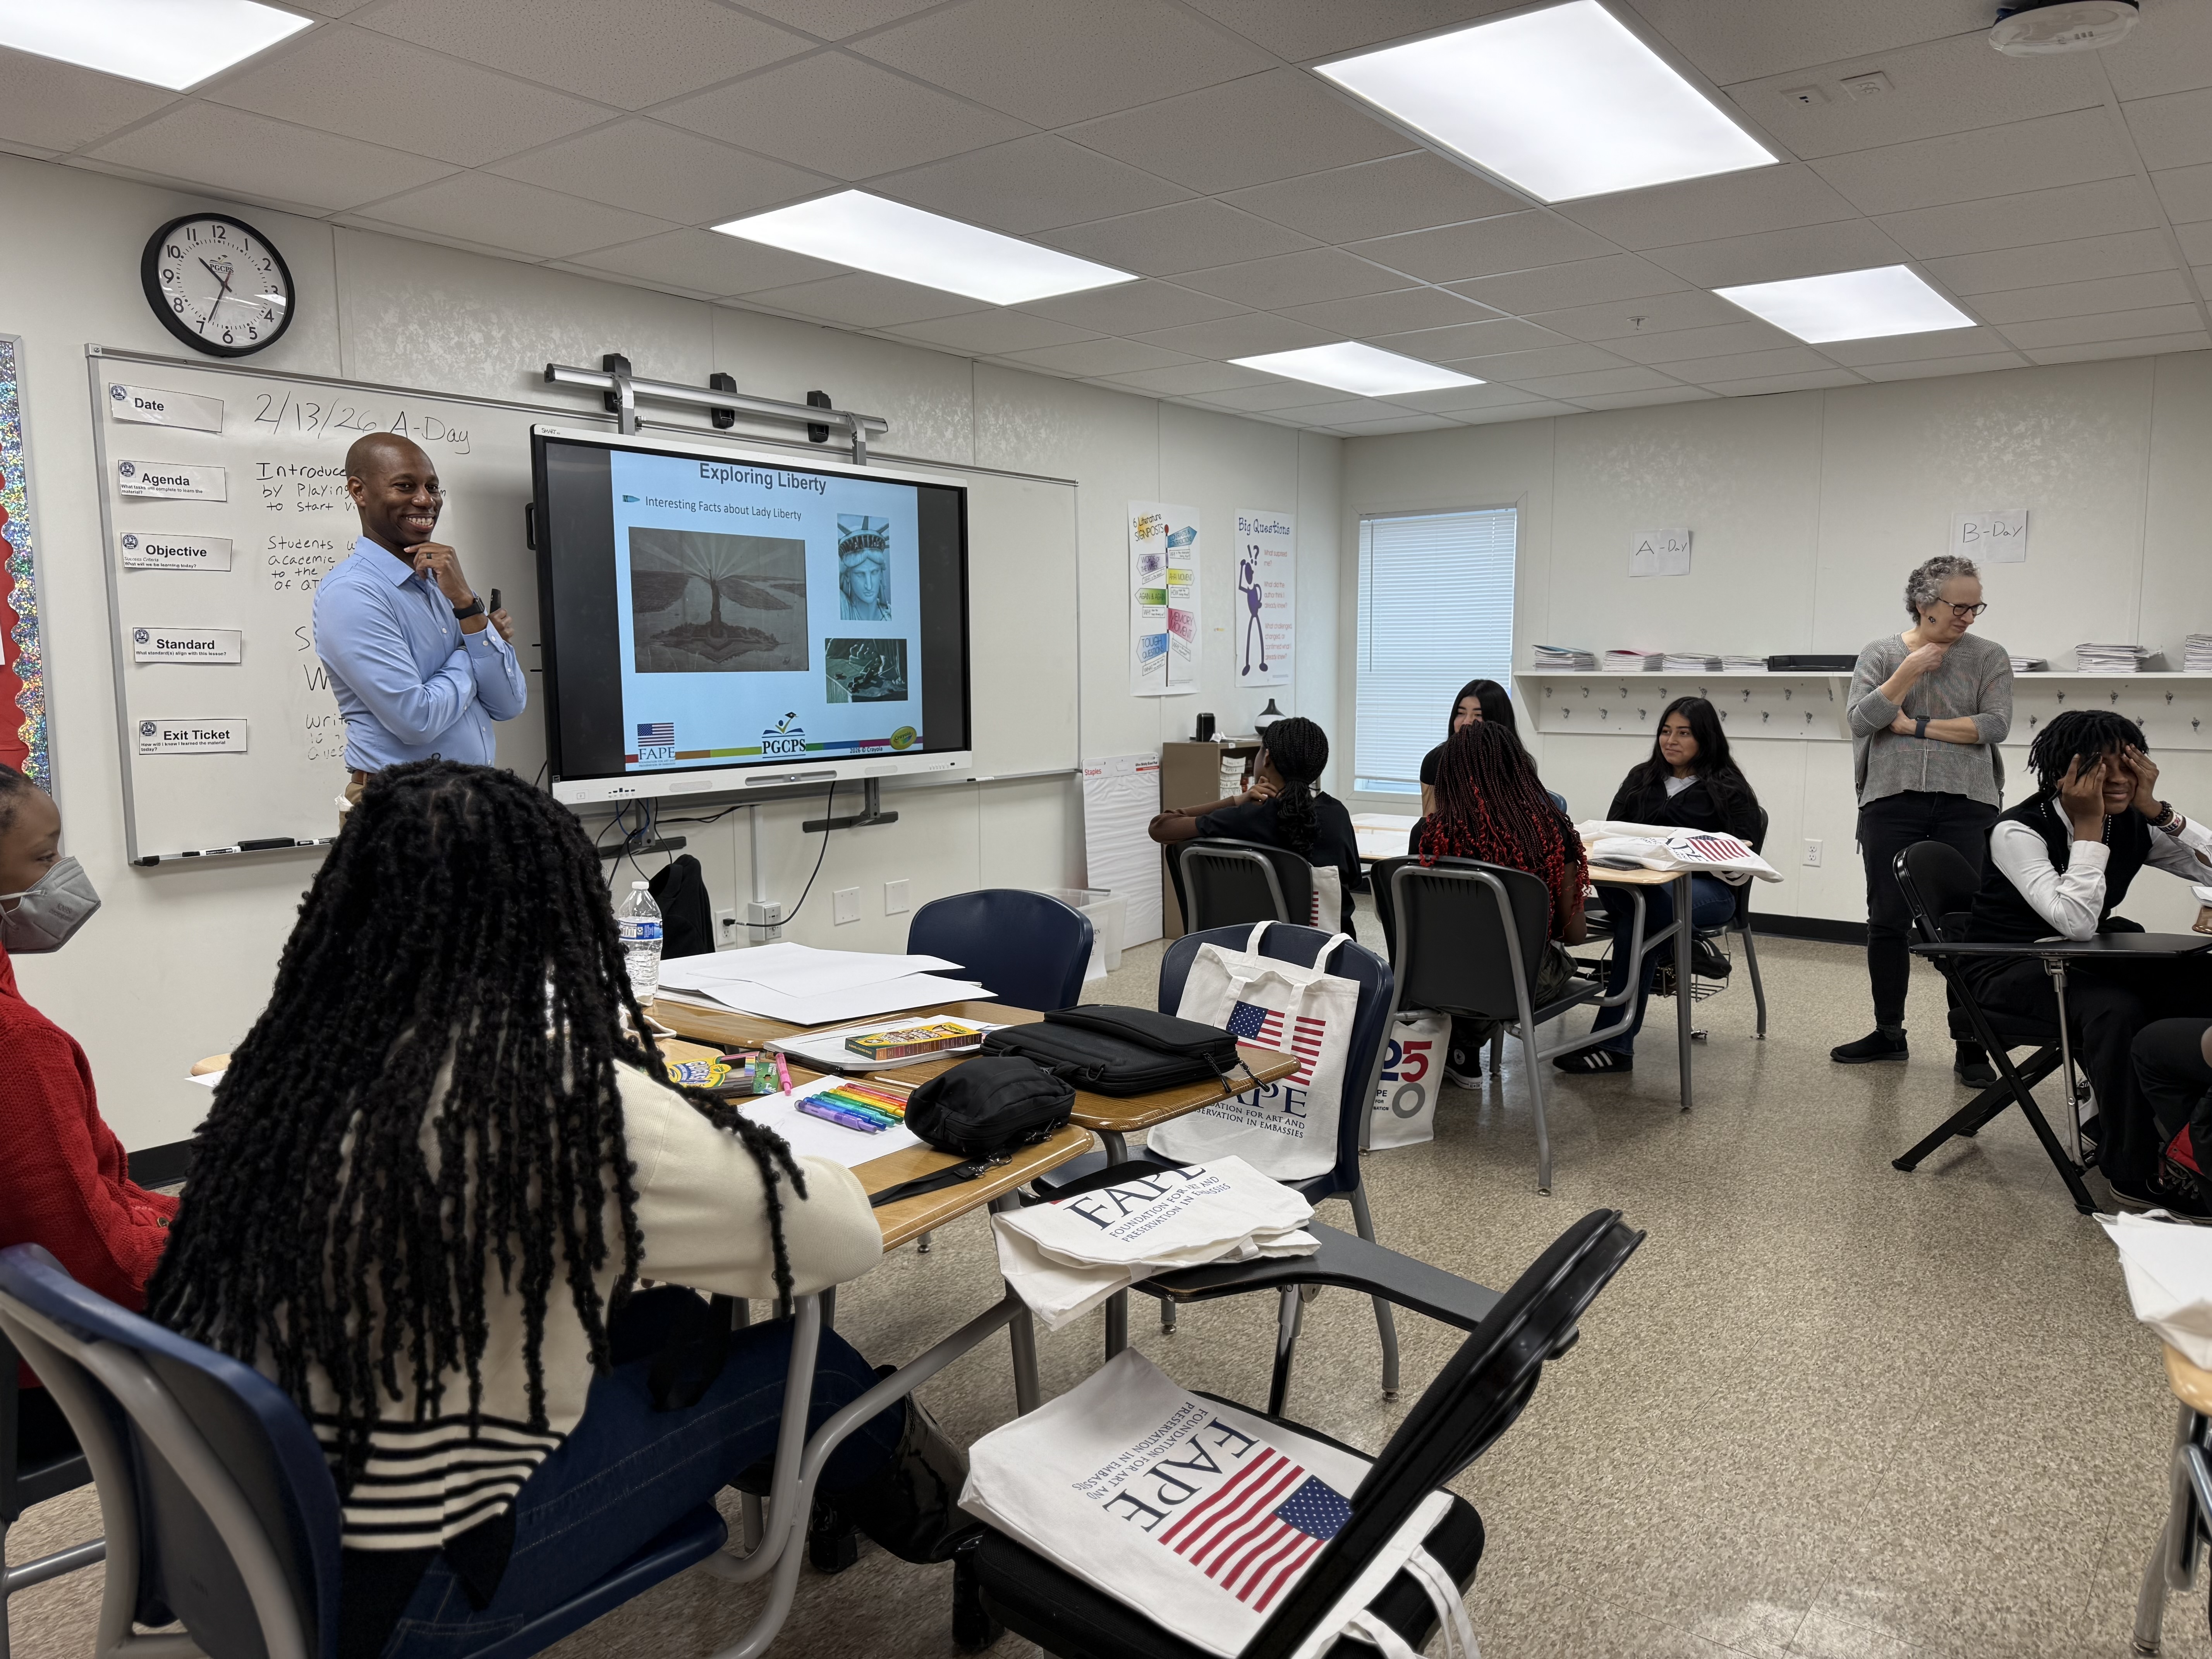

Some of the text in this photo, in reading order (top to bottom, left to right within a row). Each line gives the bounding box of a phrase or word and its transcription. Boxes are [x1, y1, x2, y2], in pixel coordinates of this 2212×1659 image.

[186, 227, 196, 242] 11
[211, 225, 226, 239] 12
[167, 244, 181, 259] 10
[244, 238, 249, 251] 1
[209, 264, 234, 273] PGCPS
[262, 258, 271, 271] 2
[163, 269, 174, 283] 9
[173, 297, 184, 313] 8
[263, 308, 275, 323] 4
[196, 320, 205, 334] 7
[249, 327, 258, 340] 5
[222, 330, 234, 344] 6
[134, 397, 164, 411] Date
[254, 391, 470, 454] 2/13/26 A-Day
[142, 473, 190, 486] Agenda
[699, 462, 827, 495] Exploring Liberty
[266, 502, 283, 511] to
[646, 496, 802, 522] Interesting Facts about Lady Liberty
[1133, 514, 1162, 528] 6 Literature
[1239, 517, 1290, 536] Big Questions
[1135, 523, 1164, 542] SIGNPOSTS
[1170, 530, 1188, 541] CONTRASTS
[1963, 521, 2023, 543] B-Day
[268, 536, 334, 550] Students
[146, 544, 207, 558] Objective
[268, 555, 335, 565] academic
[1140, 555, 1156, 563] WORDS
[271, 567, 318, 579] to the
[1170, 610, 1194, 627] MEMORY
[1170, 620, 1192, 639] MOMENT
[156, 639, 215, 650] Standard
[1142, 635, 1162, 648] TOUGH
[1142, 645, 1164, 659] QUESTIONS
[164, 729, 230, 740] Exit Ticket
[638, 747, 676, 760] FAPE
[762, 738, 806, 755] PGCPS
[1084, 768, 1102, 776] Staples
[1196, 1107, 1304, 1139] SERVATION IN EMBASSIES
[1210, 1103, 1305, 1130] DATION FOR ART AND
[1108, 1201, 1170, 1238] FOUNDATION
[1166, 1188, 1188, 1203] FOR
[1199, 1176, 1220, 1189] AND
[1121, 1206, 1183, 1243] PRESERVATION
[1180, 1195, 1195, 1206] IN
[1072, 1401, 1195, 1491] PRESERVATION IN EMBASSIES
[1086, 1408, 1209, 1499] FOUNDATION FOR ART AND
[1101, 1417, 1260, 1533] FAPE
